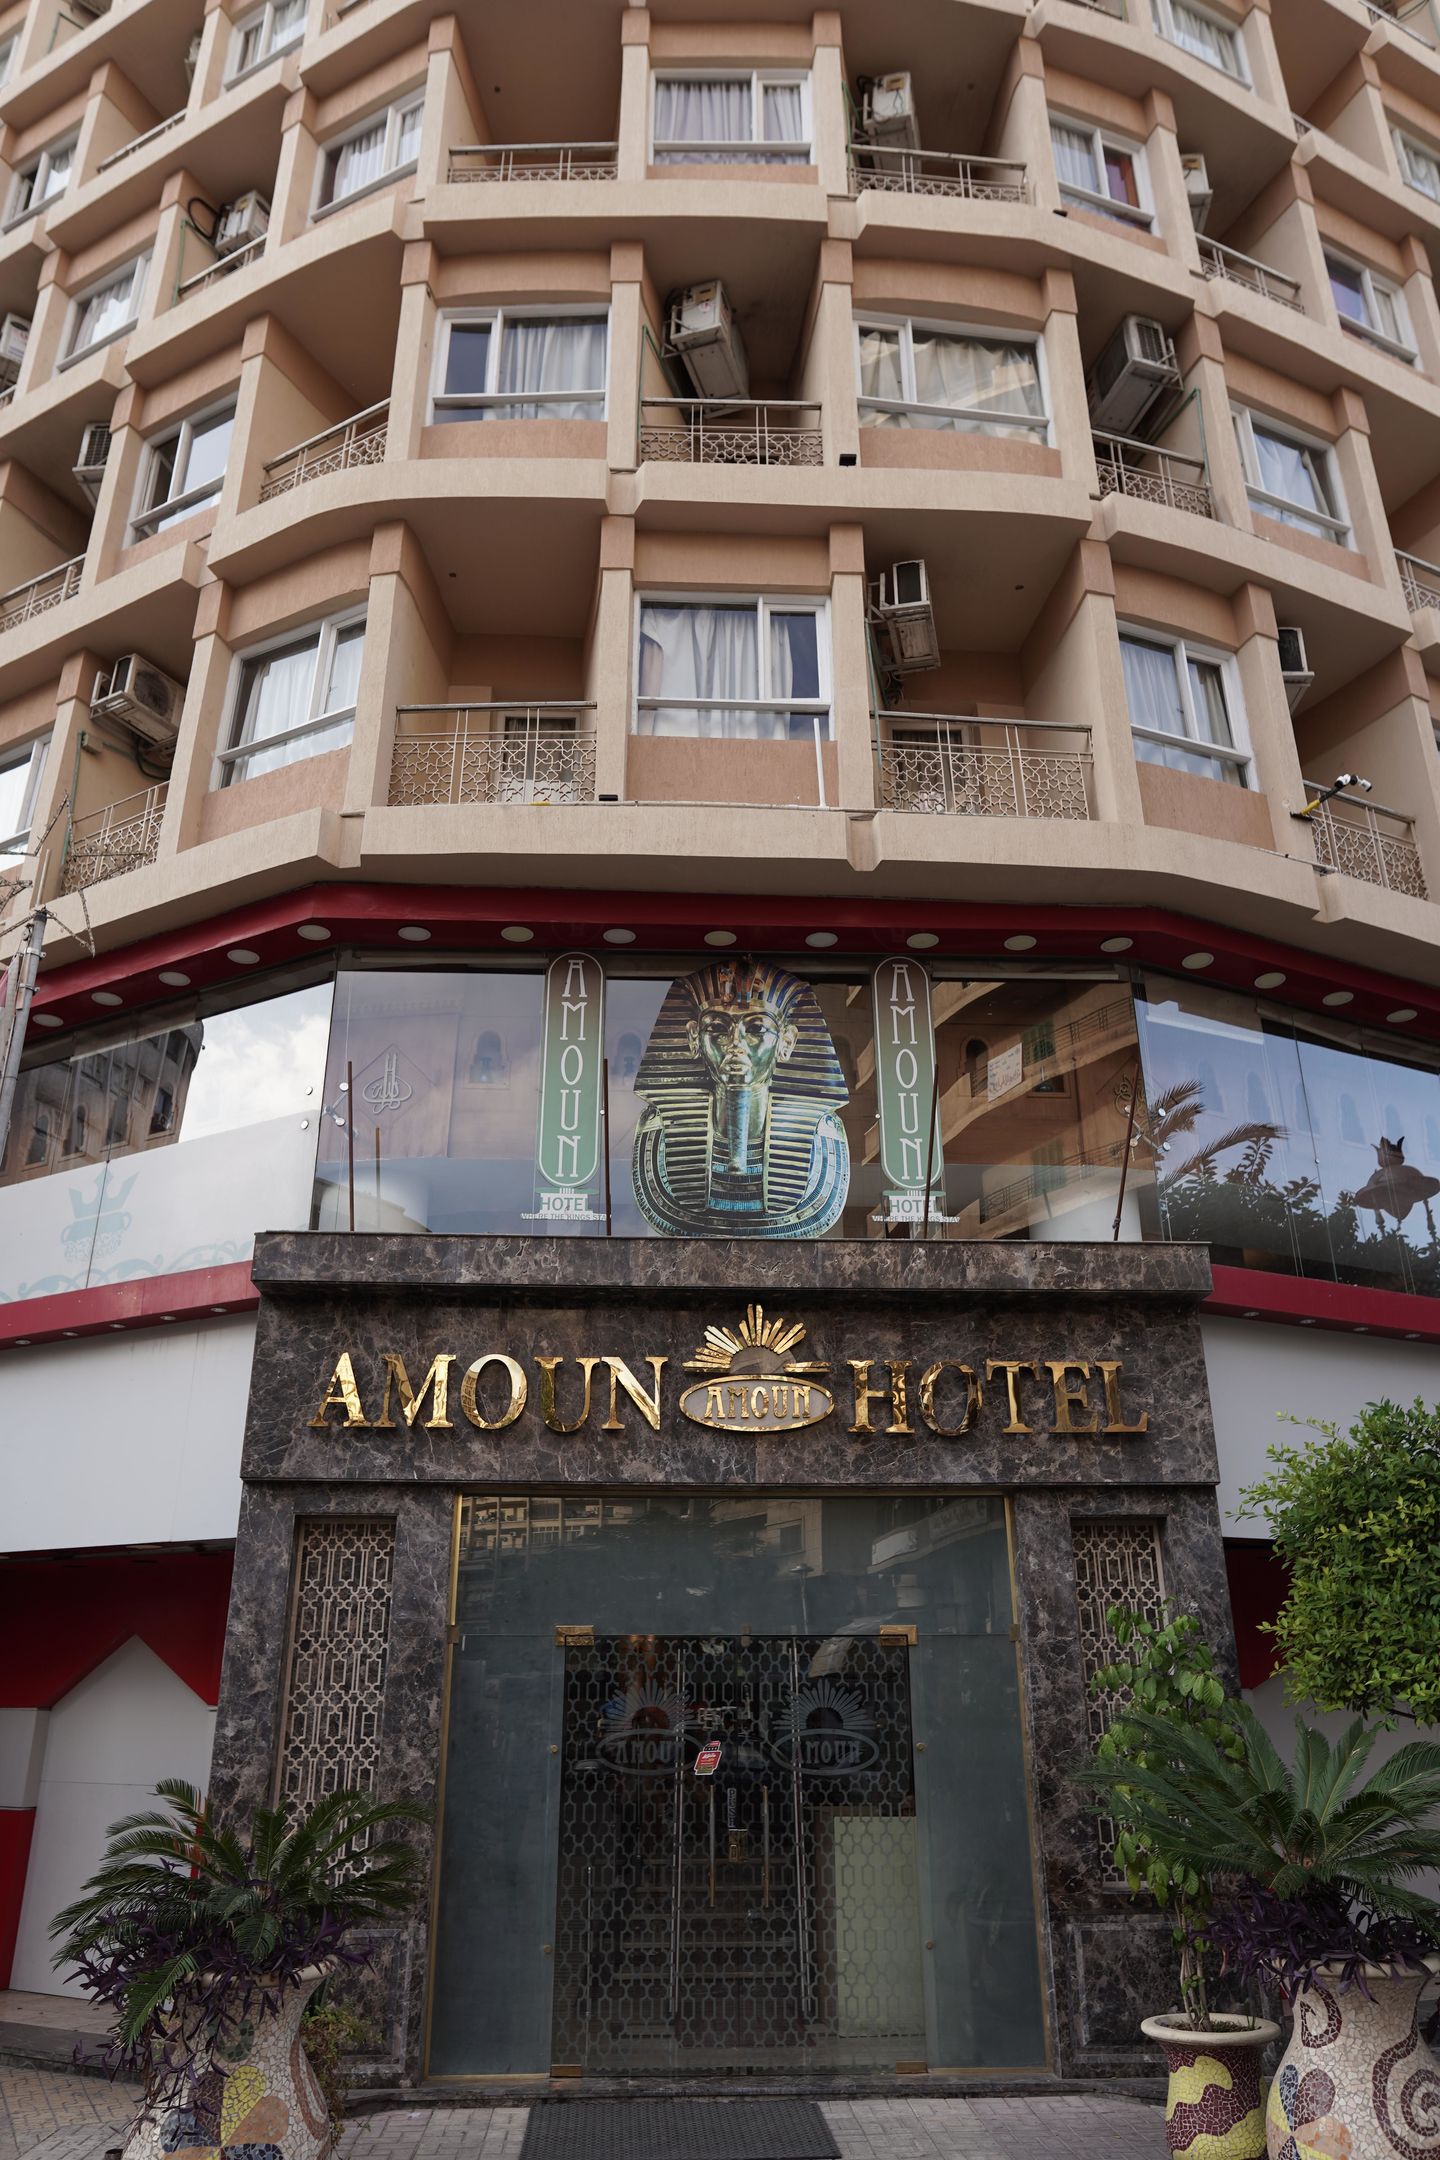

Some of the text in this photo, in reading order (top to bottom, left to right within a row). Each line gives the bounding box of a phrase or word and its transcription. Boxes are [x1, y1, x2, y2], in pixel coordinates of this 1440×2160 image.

[556, 960, 588, 1177] AMOUN
[890, 964, 924, 1180] AMOUN
[540, 1197, 591, 1211] HOTEL
[567, 1213, 591, 1221] KINGS
[306, 1352, 1148, 1436] AMOUN HOTEL
[704, 1386, 811, 1419] AMOUN
[615, 1741, 685, 1764] AMOUN
[791, 1741, 861, 1764] AMOUN
